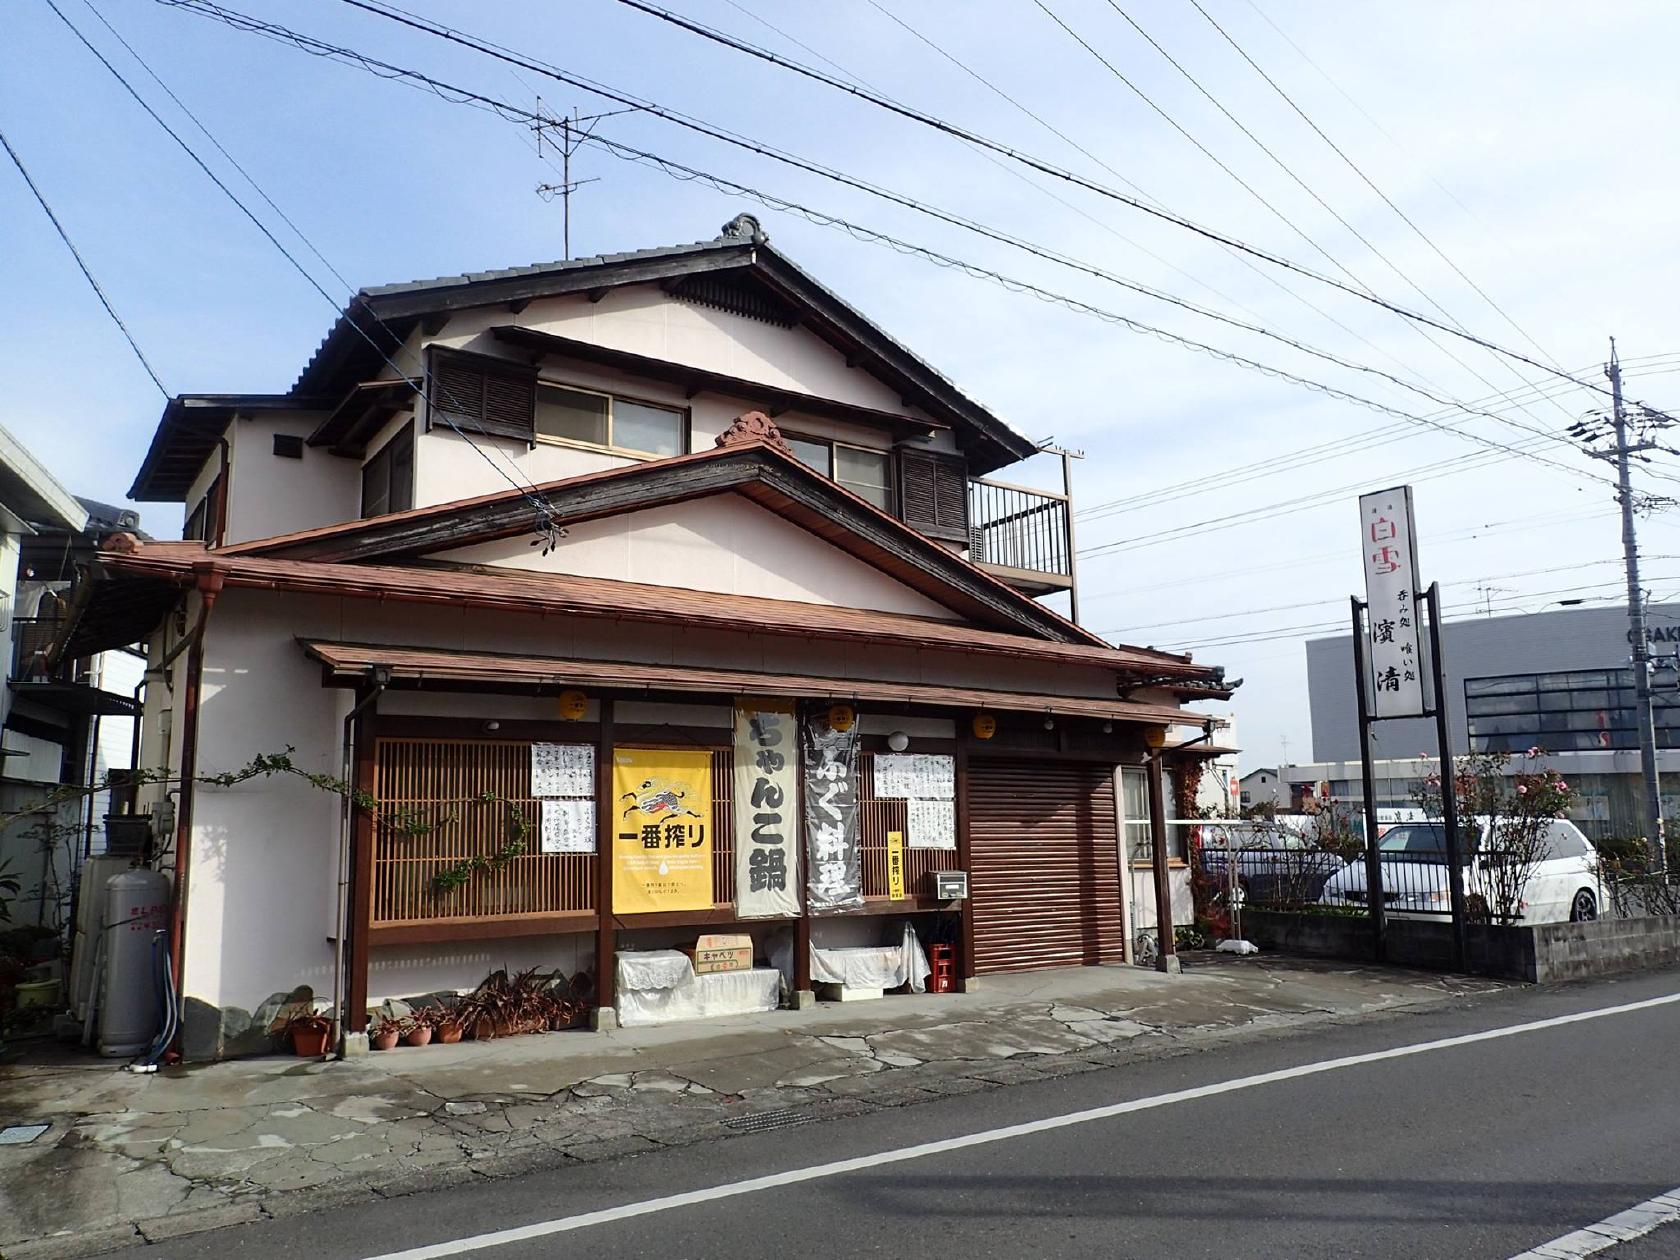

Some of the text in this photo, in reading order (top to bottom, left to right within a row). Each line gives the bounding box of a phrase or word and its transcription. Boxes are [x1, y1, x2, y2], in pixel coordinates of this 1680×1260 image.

[1371, 517, 1401, 575] 白雪
[749, 712, 787, 893] ちゃんこ鍋
[815, 745, 851, 895] ふぐ料理
[618, 824, 705, 849] 一番搾り
[703, 951, 734, 961] キャベツ
